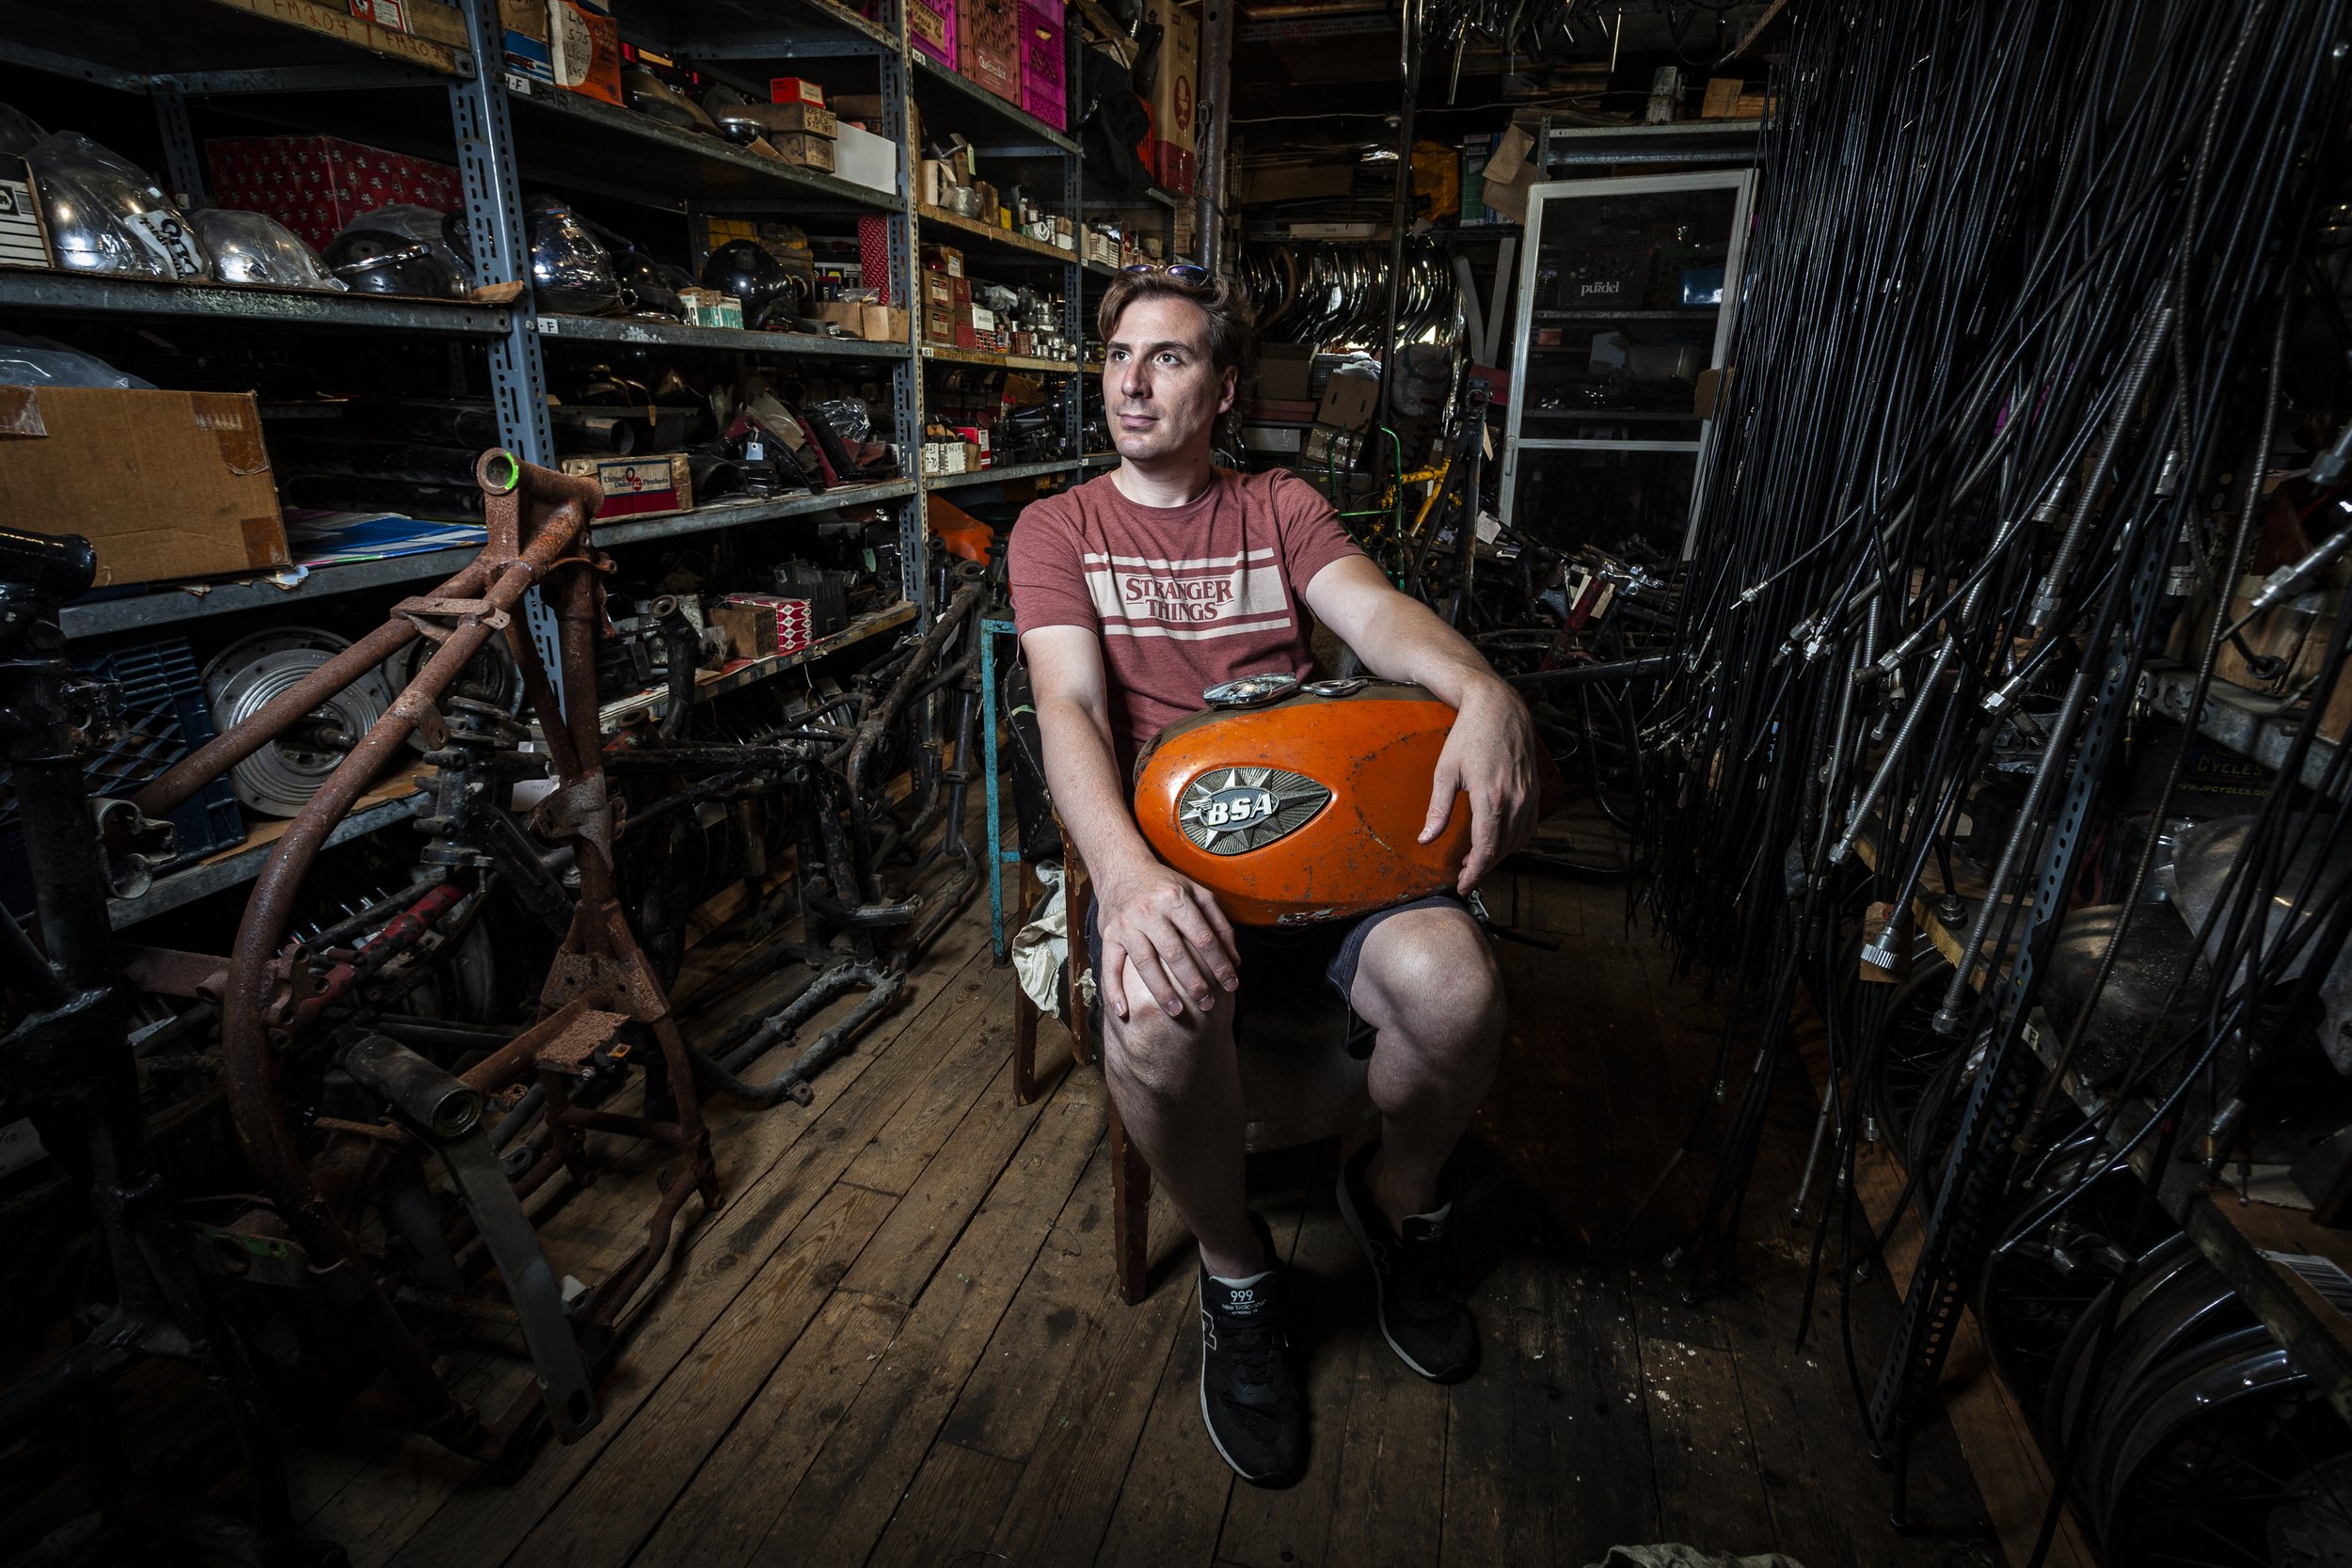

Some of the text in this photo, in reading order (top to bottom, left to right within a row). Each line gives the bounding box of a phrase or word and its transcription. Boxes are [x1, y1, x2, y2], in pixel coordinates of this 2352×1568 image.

[603, 475, 626, 483] United
[643, 477, 669, 485] Products
[1125, 577, 1234, 603] STRANGER
[1146, 598, 1218, 621] THINGS
[2197, 754, 2264, 777] CYCLES
[1207, 793, 1274, 826] BSA
[1231, 1289, 1254, 1302] 999
